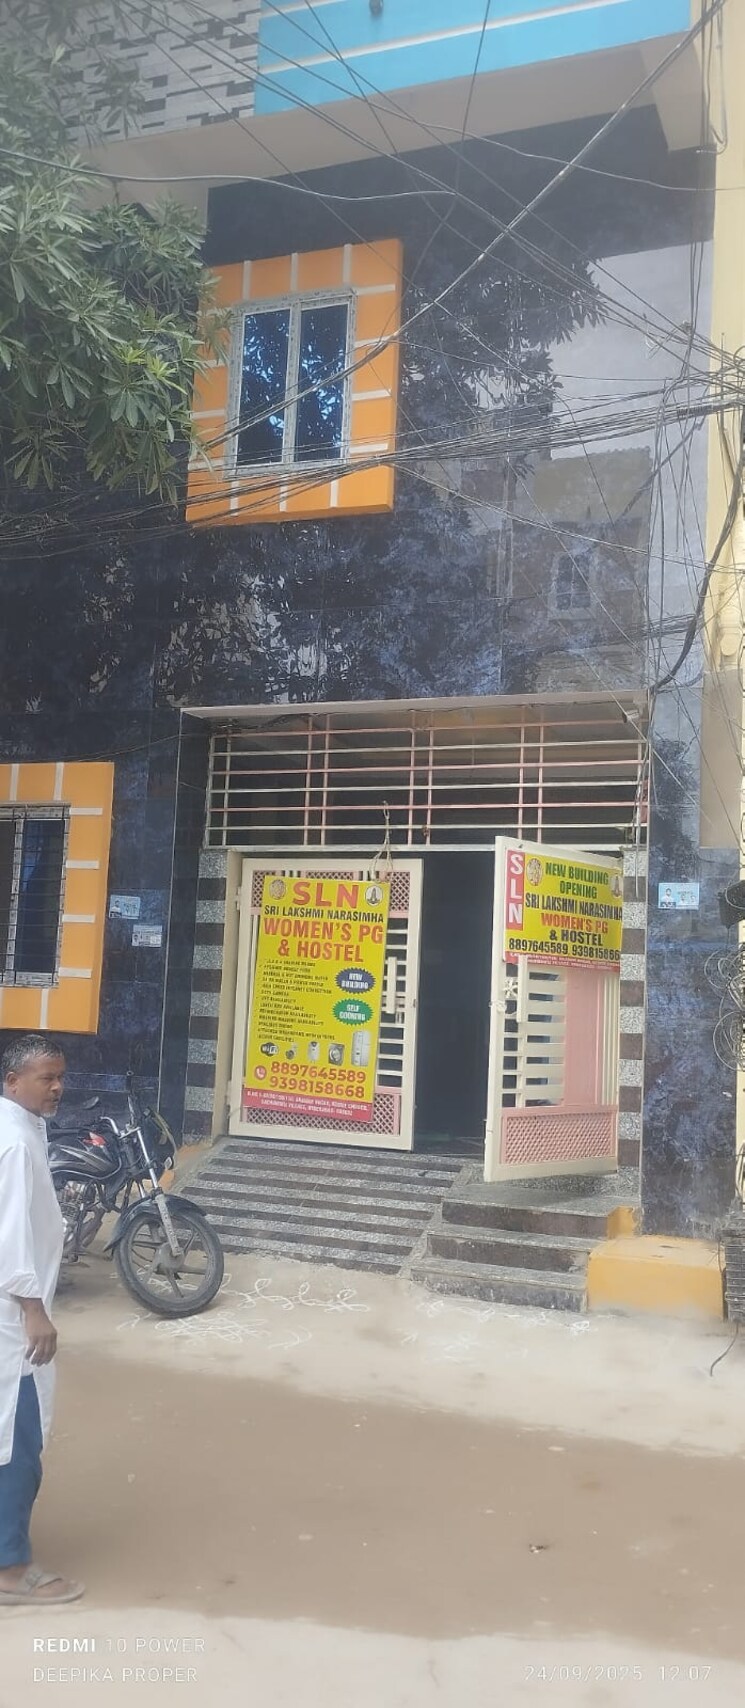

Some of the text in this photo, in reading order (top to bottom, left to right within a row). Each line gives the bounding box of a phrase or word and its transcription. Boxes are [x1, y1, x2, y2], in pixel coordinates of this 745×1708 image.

[545, 862, 609, 886] NEW BUILDING
[292, 881, 360, 909] SLN
[510, 853, 523, 924] SLN
[559, 880, 598, 899] OPENING
[264, 905, 384, 923] SRI LAKSHMI NARASIMHA
[525, 892, 540, 909] SRI
[541, 895, 578, 915] LAKSHMI
[263, 917, 384, 944] WOMEN'S PG
[541, 912, 609, 934] WOMEN'S PG
[549, 929, 604, 947] & HOSTEL
[278, 938, 365, 963] & HOSTEL
[572, 945, 621, 961] 939815866
[270, 1061, 366, 1084] 8897645589
[269, 1075, 366, 1099] 9398158668
